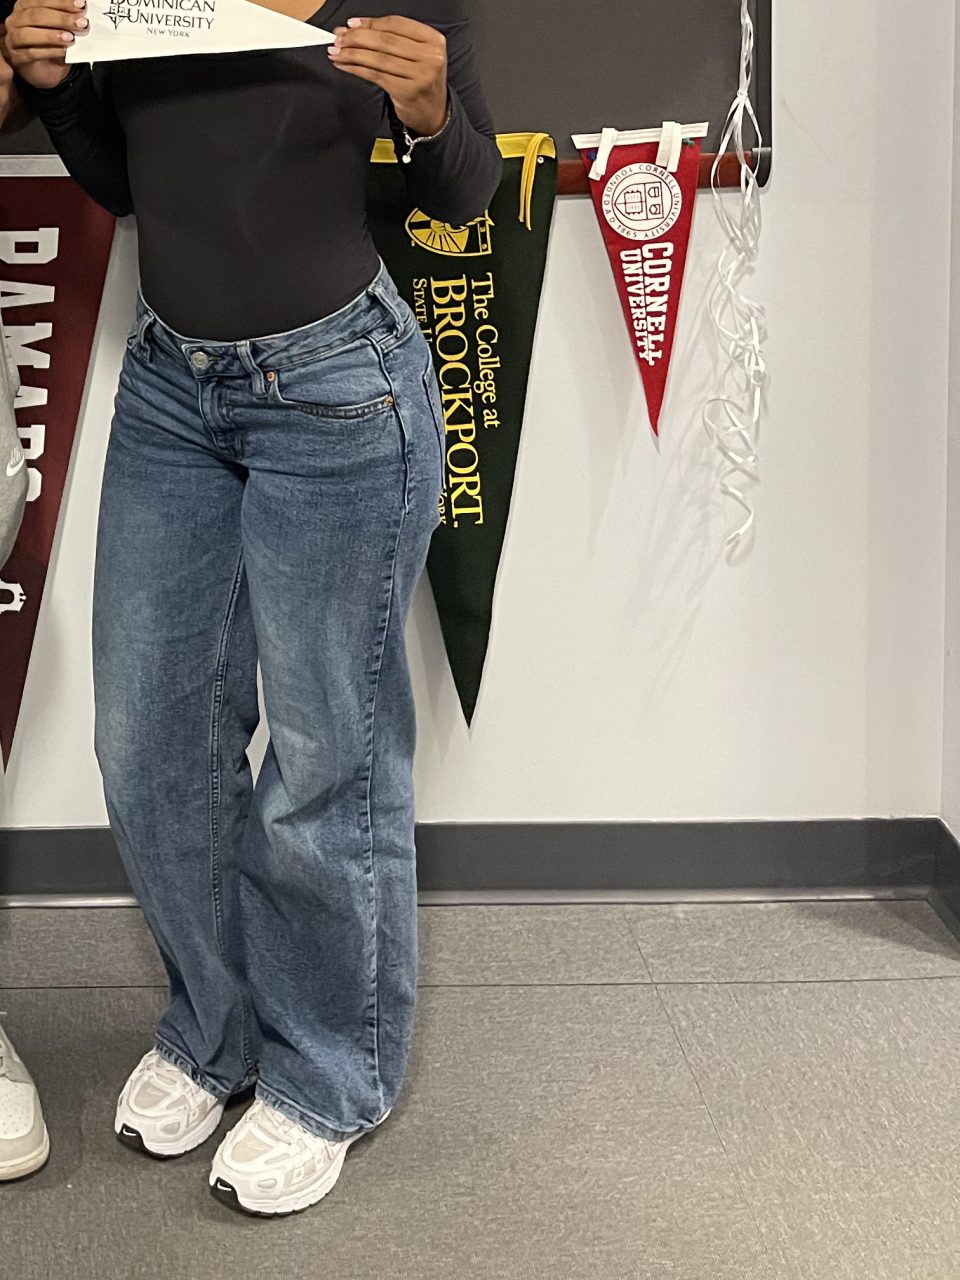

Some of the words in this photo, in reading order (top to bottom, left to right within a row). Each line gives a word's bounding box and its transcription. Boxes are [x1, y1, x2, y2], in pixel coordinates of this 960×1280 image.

[471, 272, 494, 320] The
[619, 248, 650, 362] UNIVERSITY
[641, 241, 674, 366] CORNELL
[473, 325, 501, 404] College
[482, 409, 501, 429] at
